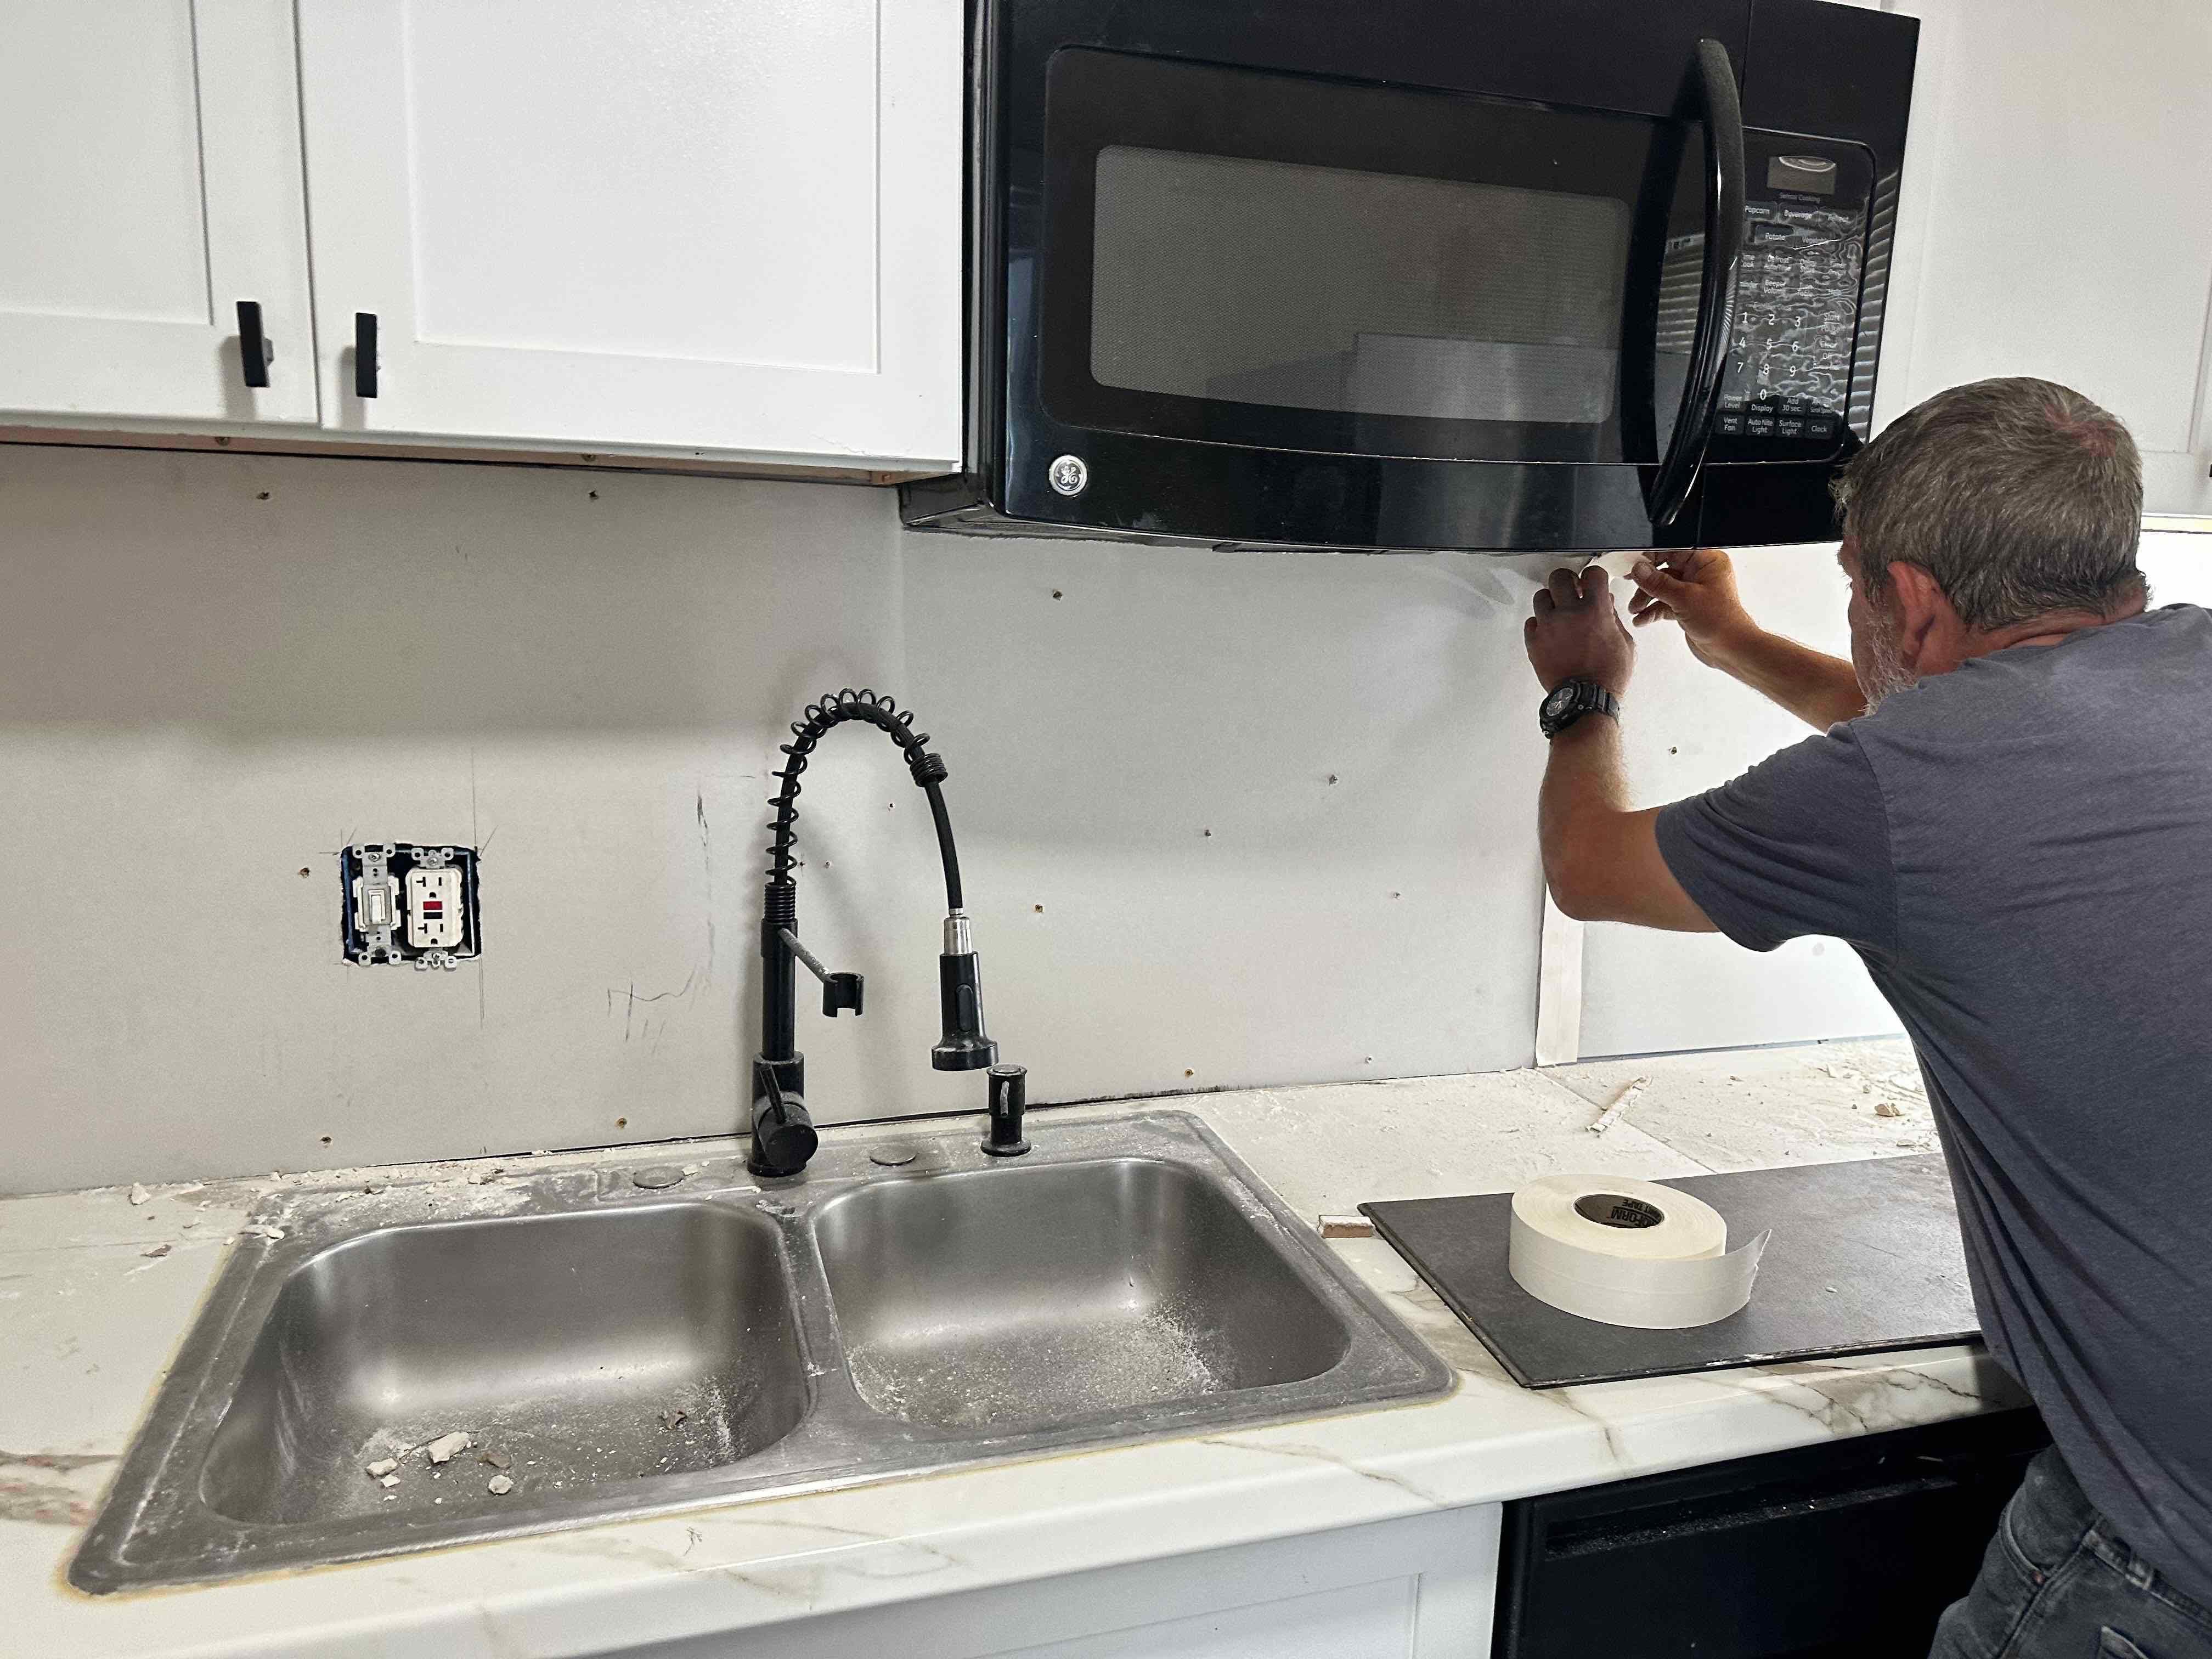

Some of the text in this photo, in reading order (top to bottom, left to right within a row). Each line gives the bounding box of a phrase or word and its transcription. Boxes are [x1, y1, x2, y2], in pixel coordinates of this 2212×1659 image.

[1745, 205, 1770, 215] Popcorn
[1742, 312, 1748, 324] 1
[1769, 314, 1775, 325] 2
[1795, 316, 1801, 328] 3
[1739, 337, 1746, 348] 4
[1766, 339, 1773, 350] 5
[1792, 341, 1798, 352] 6
[1737, 362, 1744, 373] 7
[1763, 364, 1770, 375] 8
[1790, 365, 1796, 377] 9
[1724, 394, 1743, 402] Power
[1759, 388, 1767, 400] 0
[1751, 404, 1774, 414] Display
[1752, 427, 1768, 435] Light
[1782, 427, 1797, 436] Light
